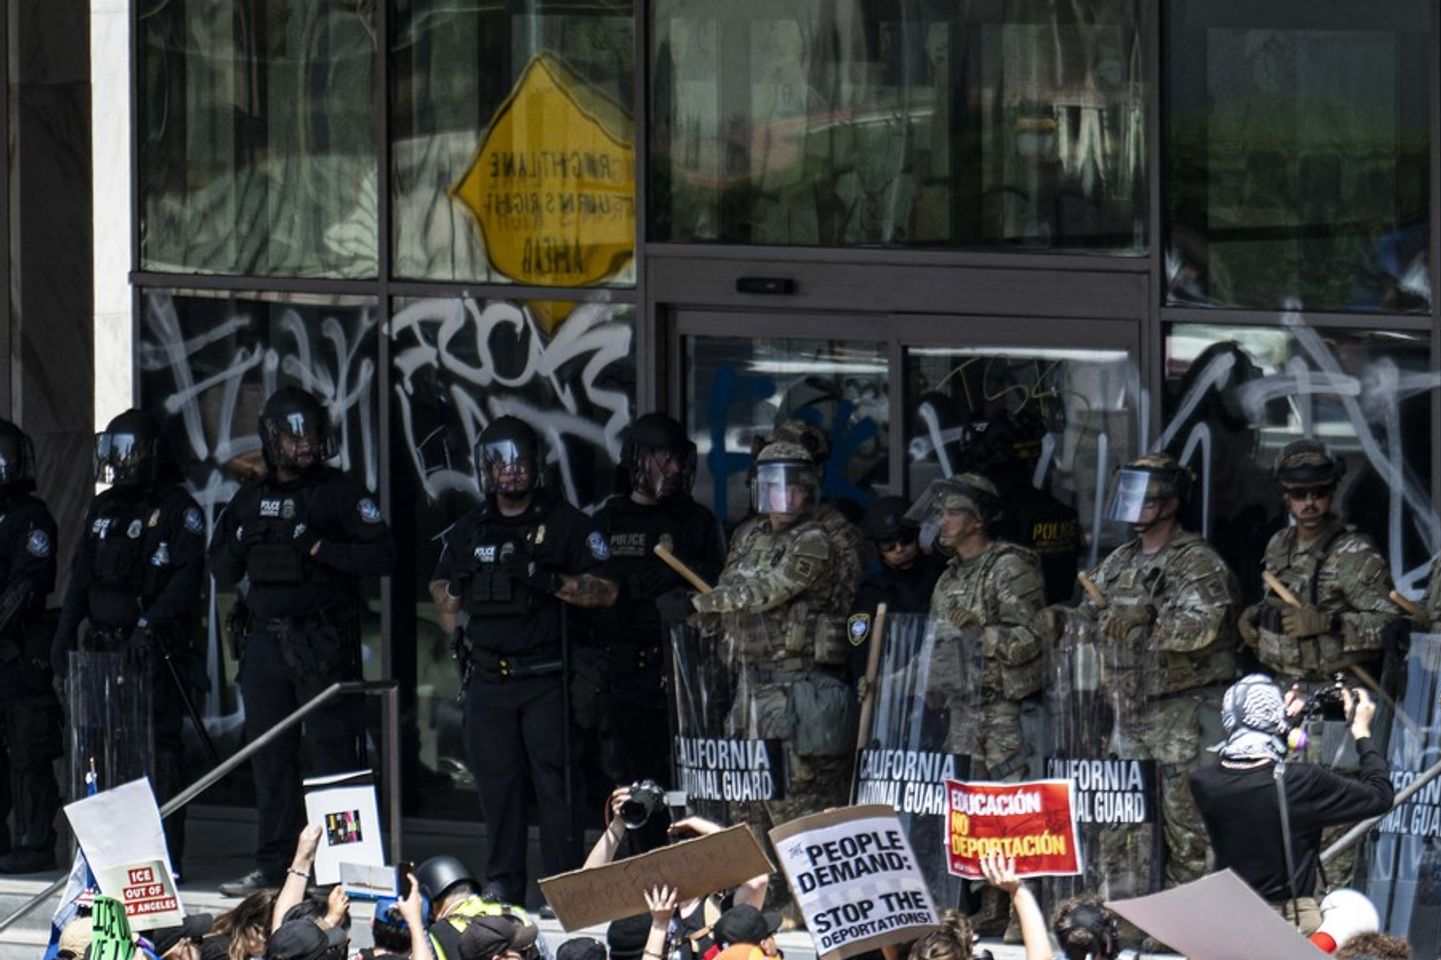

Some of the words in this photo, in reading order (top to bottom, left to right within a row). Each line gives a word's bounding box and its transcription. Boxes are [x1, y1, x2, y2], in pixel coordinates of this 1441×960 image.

[859, 750, 955, 781] CALIFORNIA
[723, 770, 773, 802] GUARD
[904, 783, 948, 816] GUAR
[951, 788, 1042, 817] EDUCACIÓN
[1094, 792, 1145, 823] GUARD
[951, 811, 970, 835] NO
[805, 831, 905, 867] PEOPLE
[951, 829, 1067, 858] DEPORTACIÓN
[130, 869, 151, 883] ICE
[797, 851, 913, 895] DEMAND:
[125, 888, 146, 899] OUT
[148, 886, 162, 896] OF
[137, 899, 177, 913] ANGELES
[813, 899, 875, 934] STOP
[878, 890, 928, 914] THE
[821, 911, 934, 950] DEPORTATIONS!
